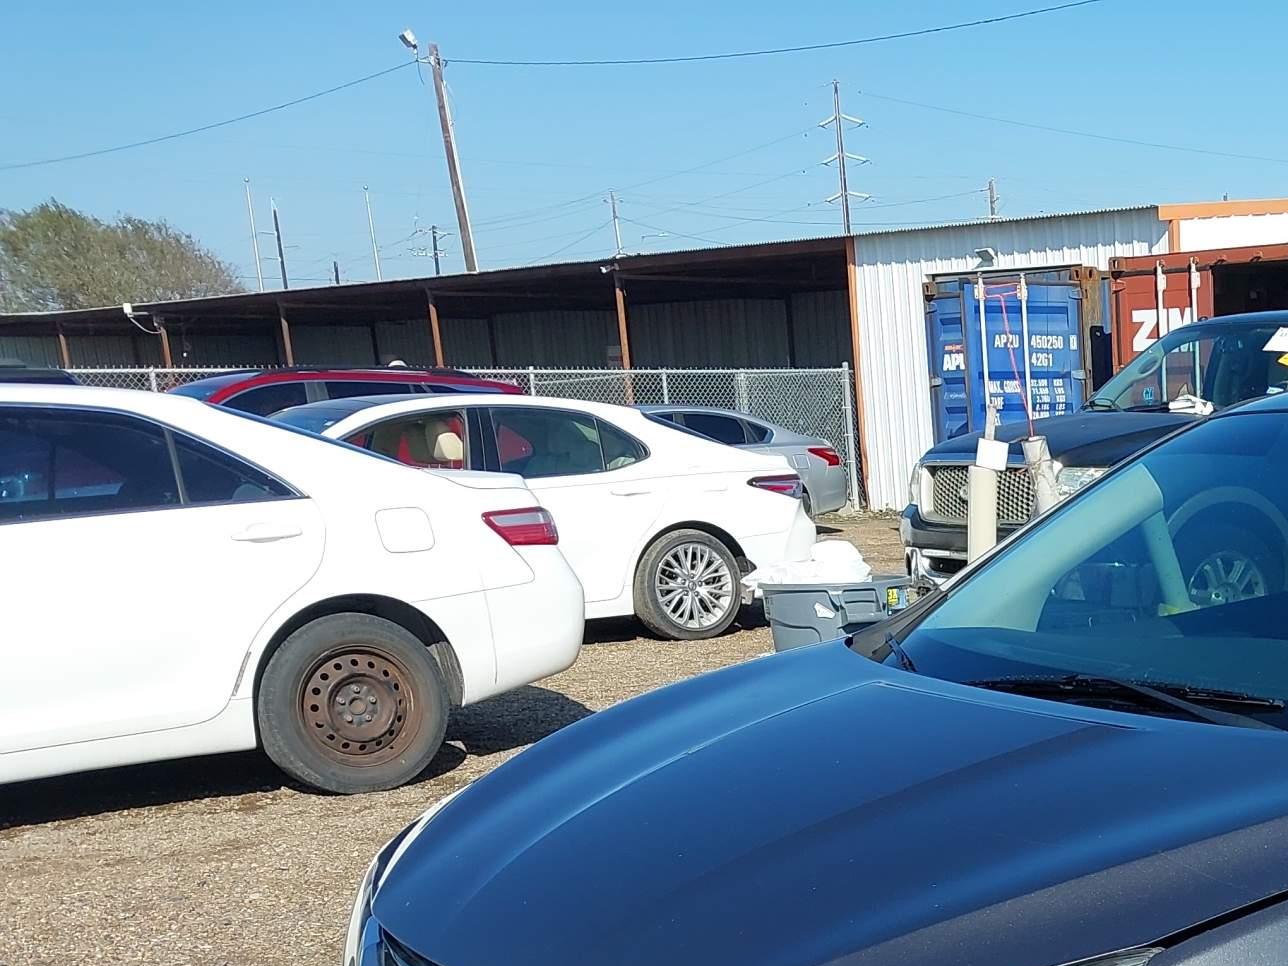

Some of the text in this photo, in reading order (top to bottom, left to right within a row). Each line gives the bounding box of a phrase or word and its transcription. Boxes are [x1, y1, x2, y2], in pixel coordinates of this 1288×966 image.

[1131, 306, 1194, 353] ZIM
[994, 334, 1020, 348] APZU
[1031, 352, 1053, 367] 42G1
